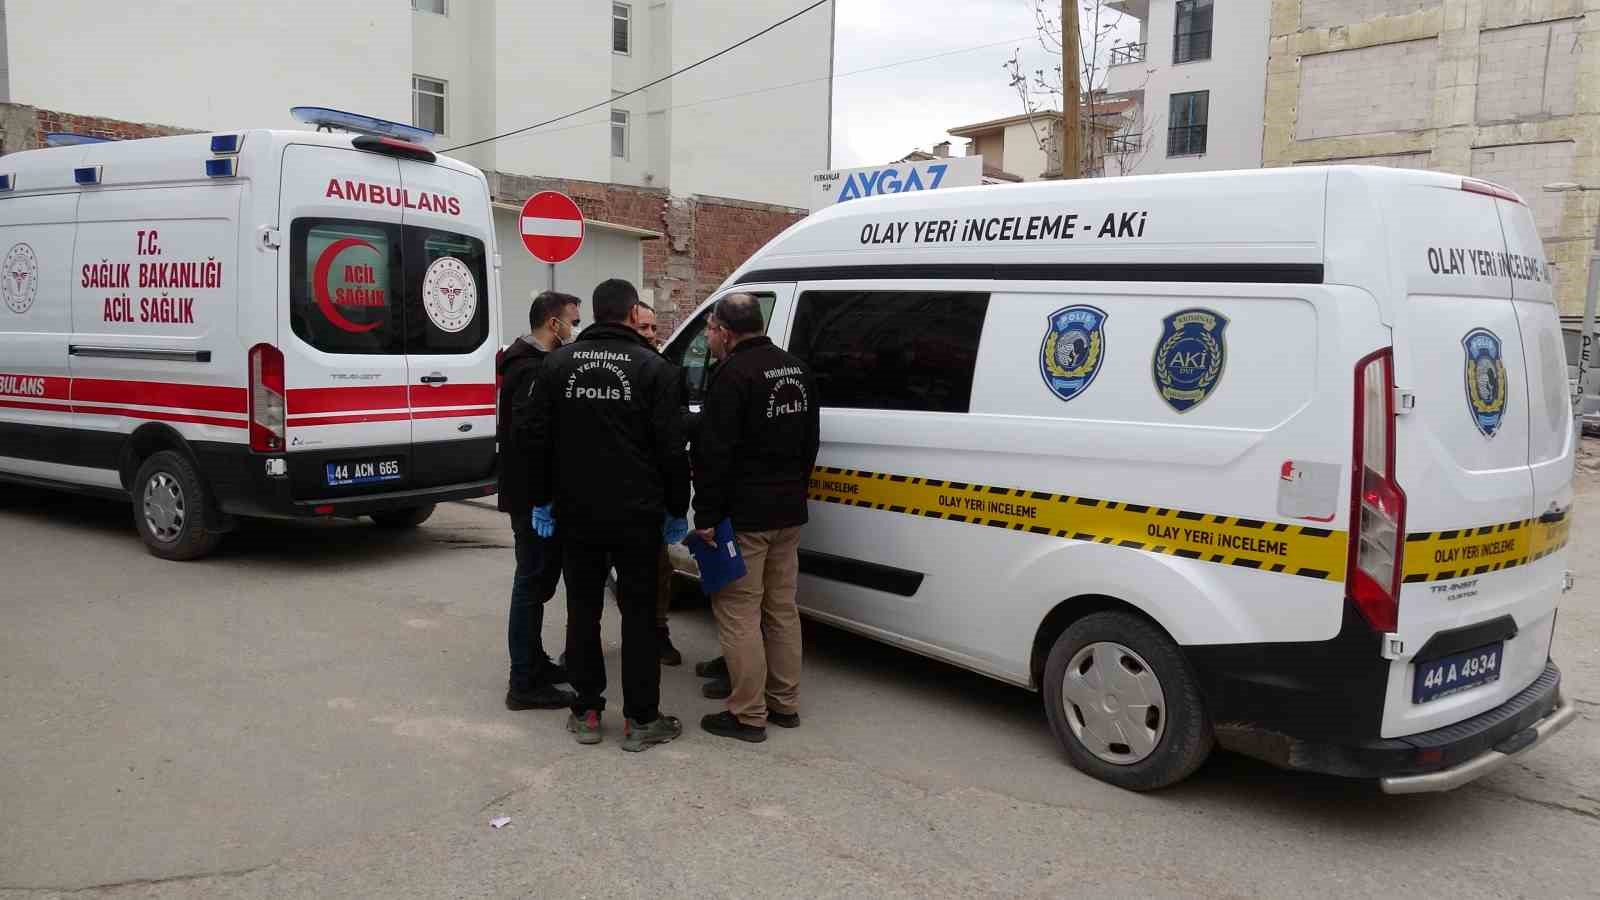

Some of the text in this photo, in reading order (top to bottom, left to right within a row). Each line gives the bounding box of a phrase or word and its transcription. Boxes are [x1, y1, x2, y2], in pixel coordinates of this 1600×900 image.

[326, 178, 461, 216] AMBULANS
[137, 230, 161, 255] T.C.
[860, 222, 909, 245] OLAY
[81, 256, 222, 288] SAĞLIK BAKANLIĞI
[1427, 247, 1465, 275] OLAY
[104, 292, 194, 324] ACİL SAĞLIK
[573, 350, 632, 361] KRİMİNAL
[0, 375, 45, 396] BULANS
[565, 373, 577, 398] OLAY
[577, 360, 600, 373] YERİ
[576, 386, 621, 399] POLİS
[335, 461, 399, 479] 44 ACN 665
[939, 495, 962, 508] OLAY
[1147, 523, 1180, 540] OLAY
[1434, 548, 1461, 564] OLAY
[1424, 666, 1443, 688] 44
[1446, 663, 1457, 683] A
[1461, 652, 1497, 678] 4934
